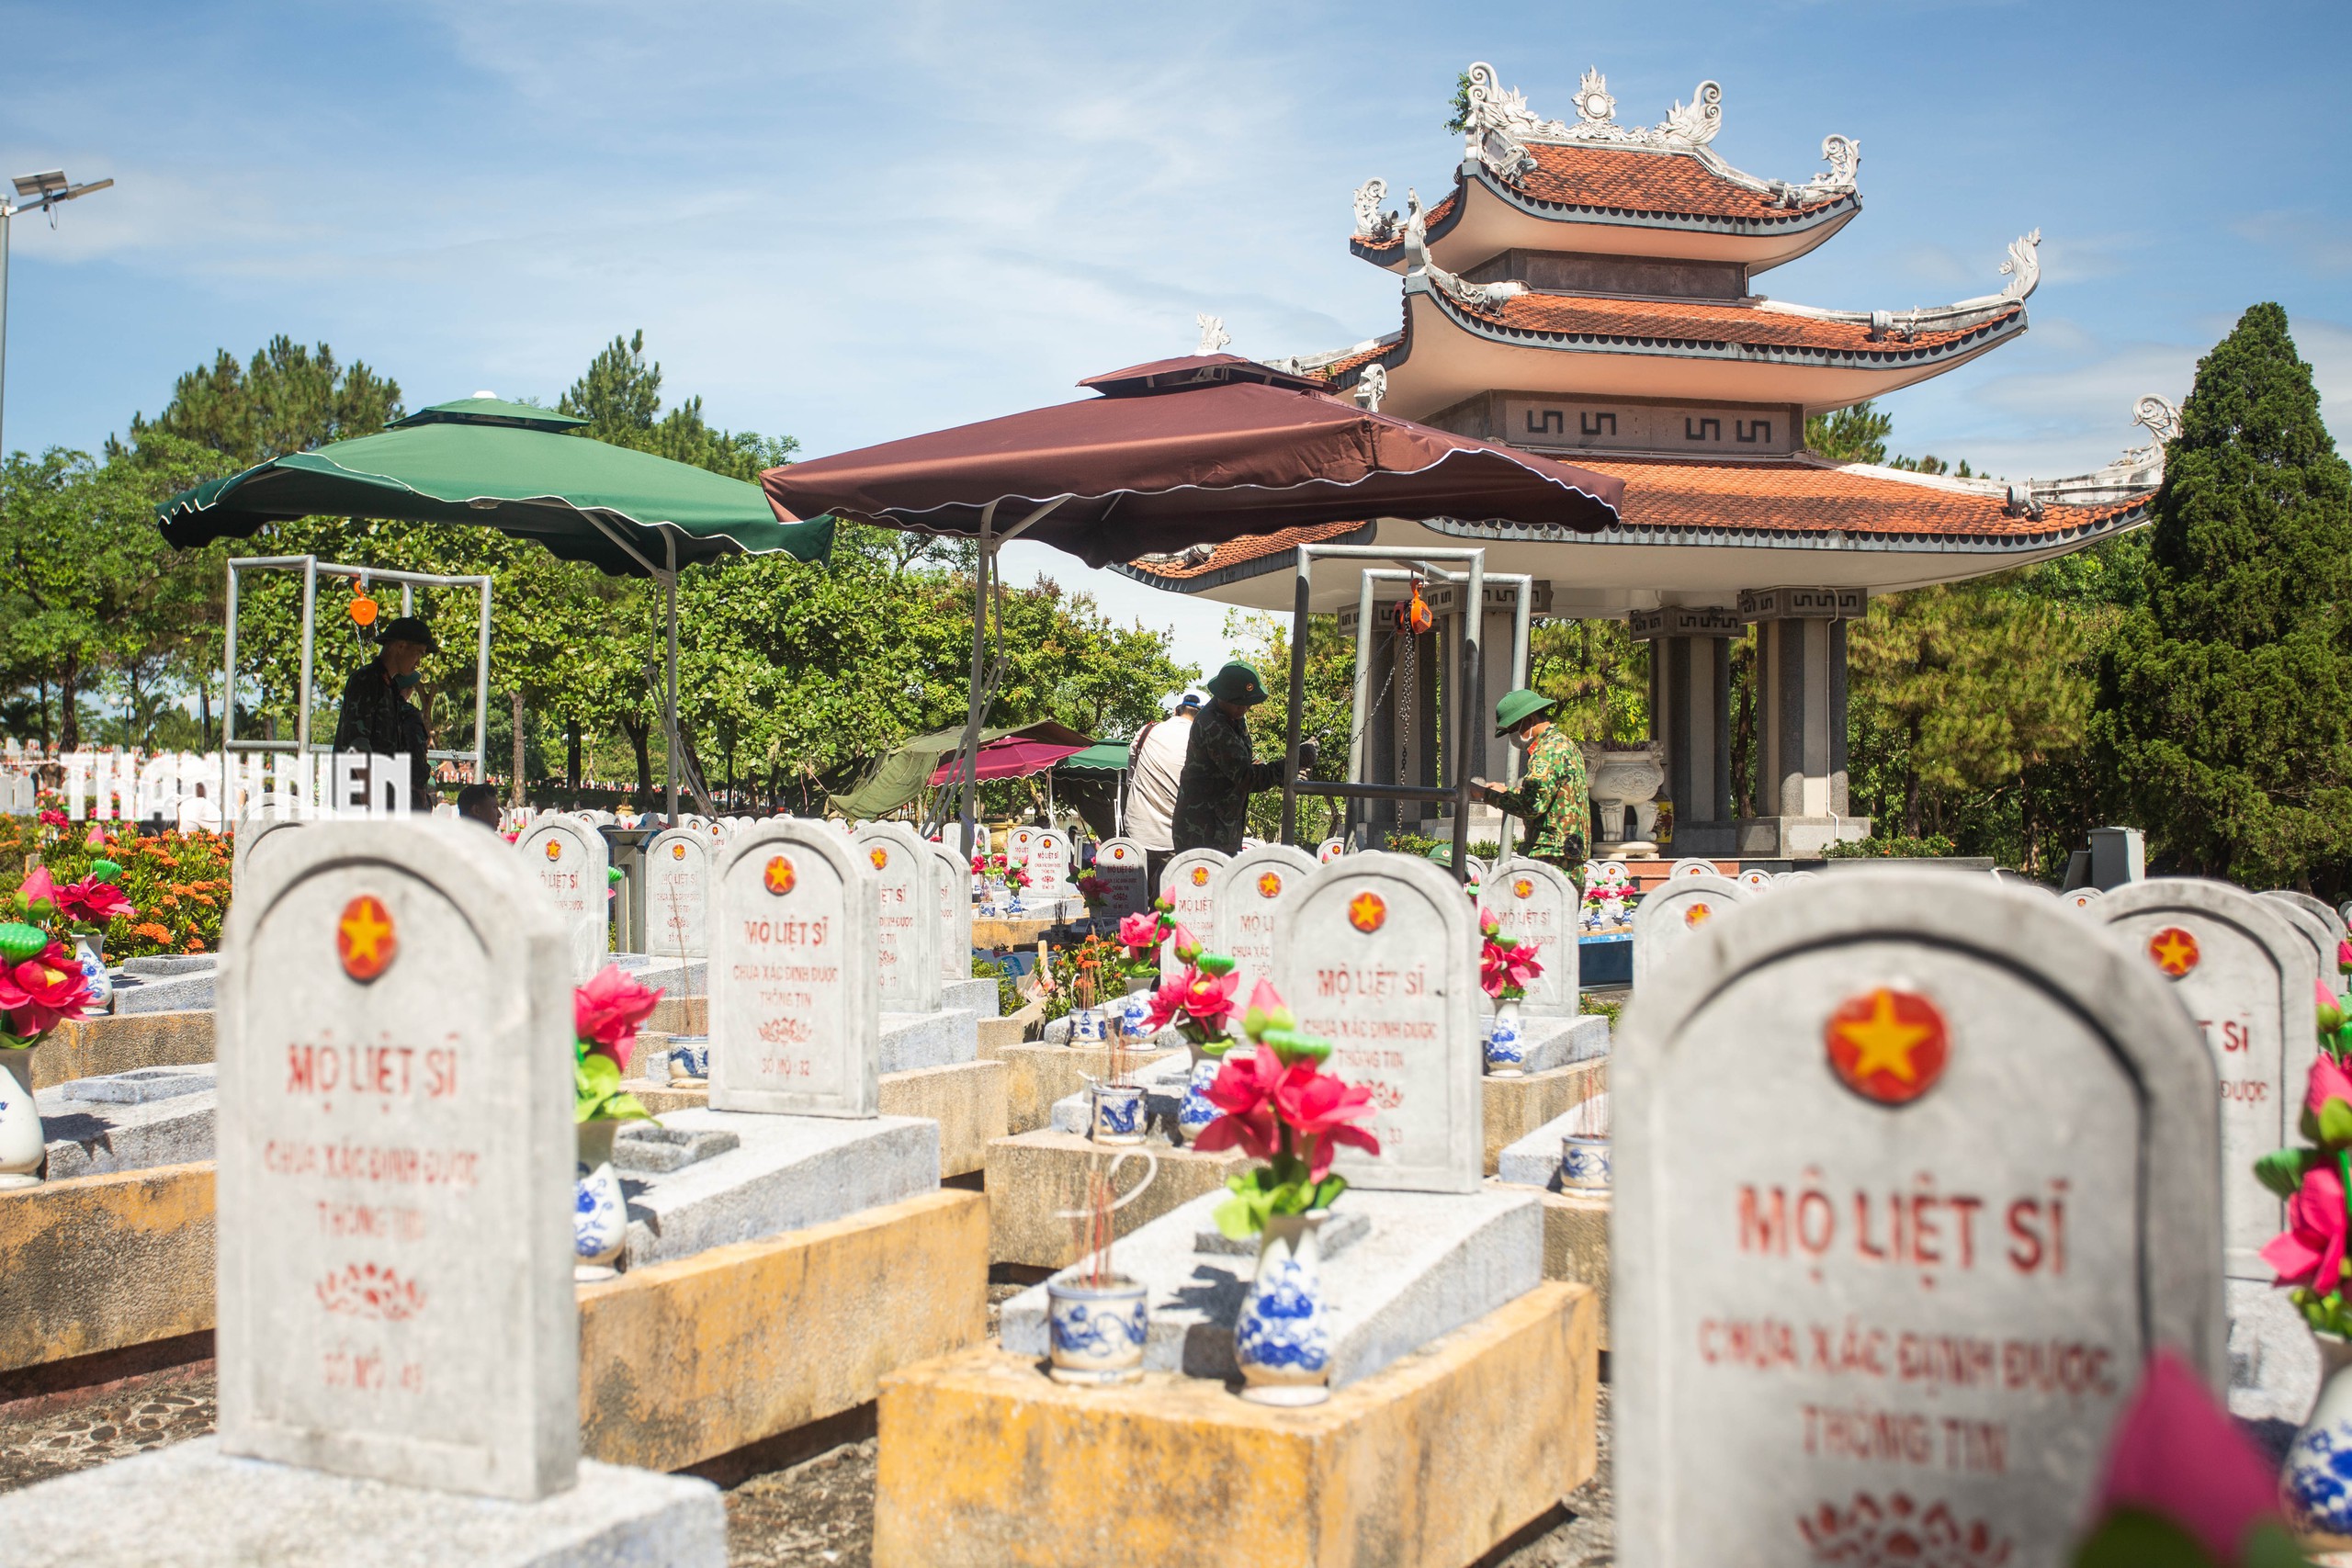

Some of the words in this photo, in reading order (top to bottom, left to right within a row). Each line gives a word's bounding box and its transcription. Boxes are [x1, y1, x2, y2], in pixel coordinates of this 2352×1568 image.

[744, 915, 770, 952] MỘ
[775, 915, 808, 952] LIỆT
[812, 916, 829, 946] SĨ
[1317, 962, 1350, 1006] MỘ
[1356, 962, 1397, 1004] LIỆT
[1405, 963, 1426, 997] SĨ
[2222, 1011, 2251, 1053] SĨ
[1737, 1164, 1834, 1285] MỘ
[1853, 1170, 1984, 1290] LIỆT
[2006, 1178, 2071, 1276] SĨ
